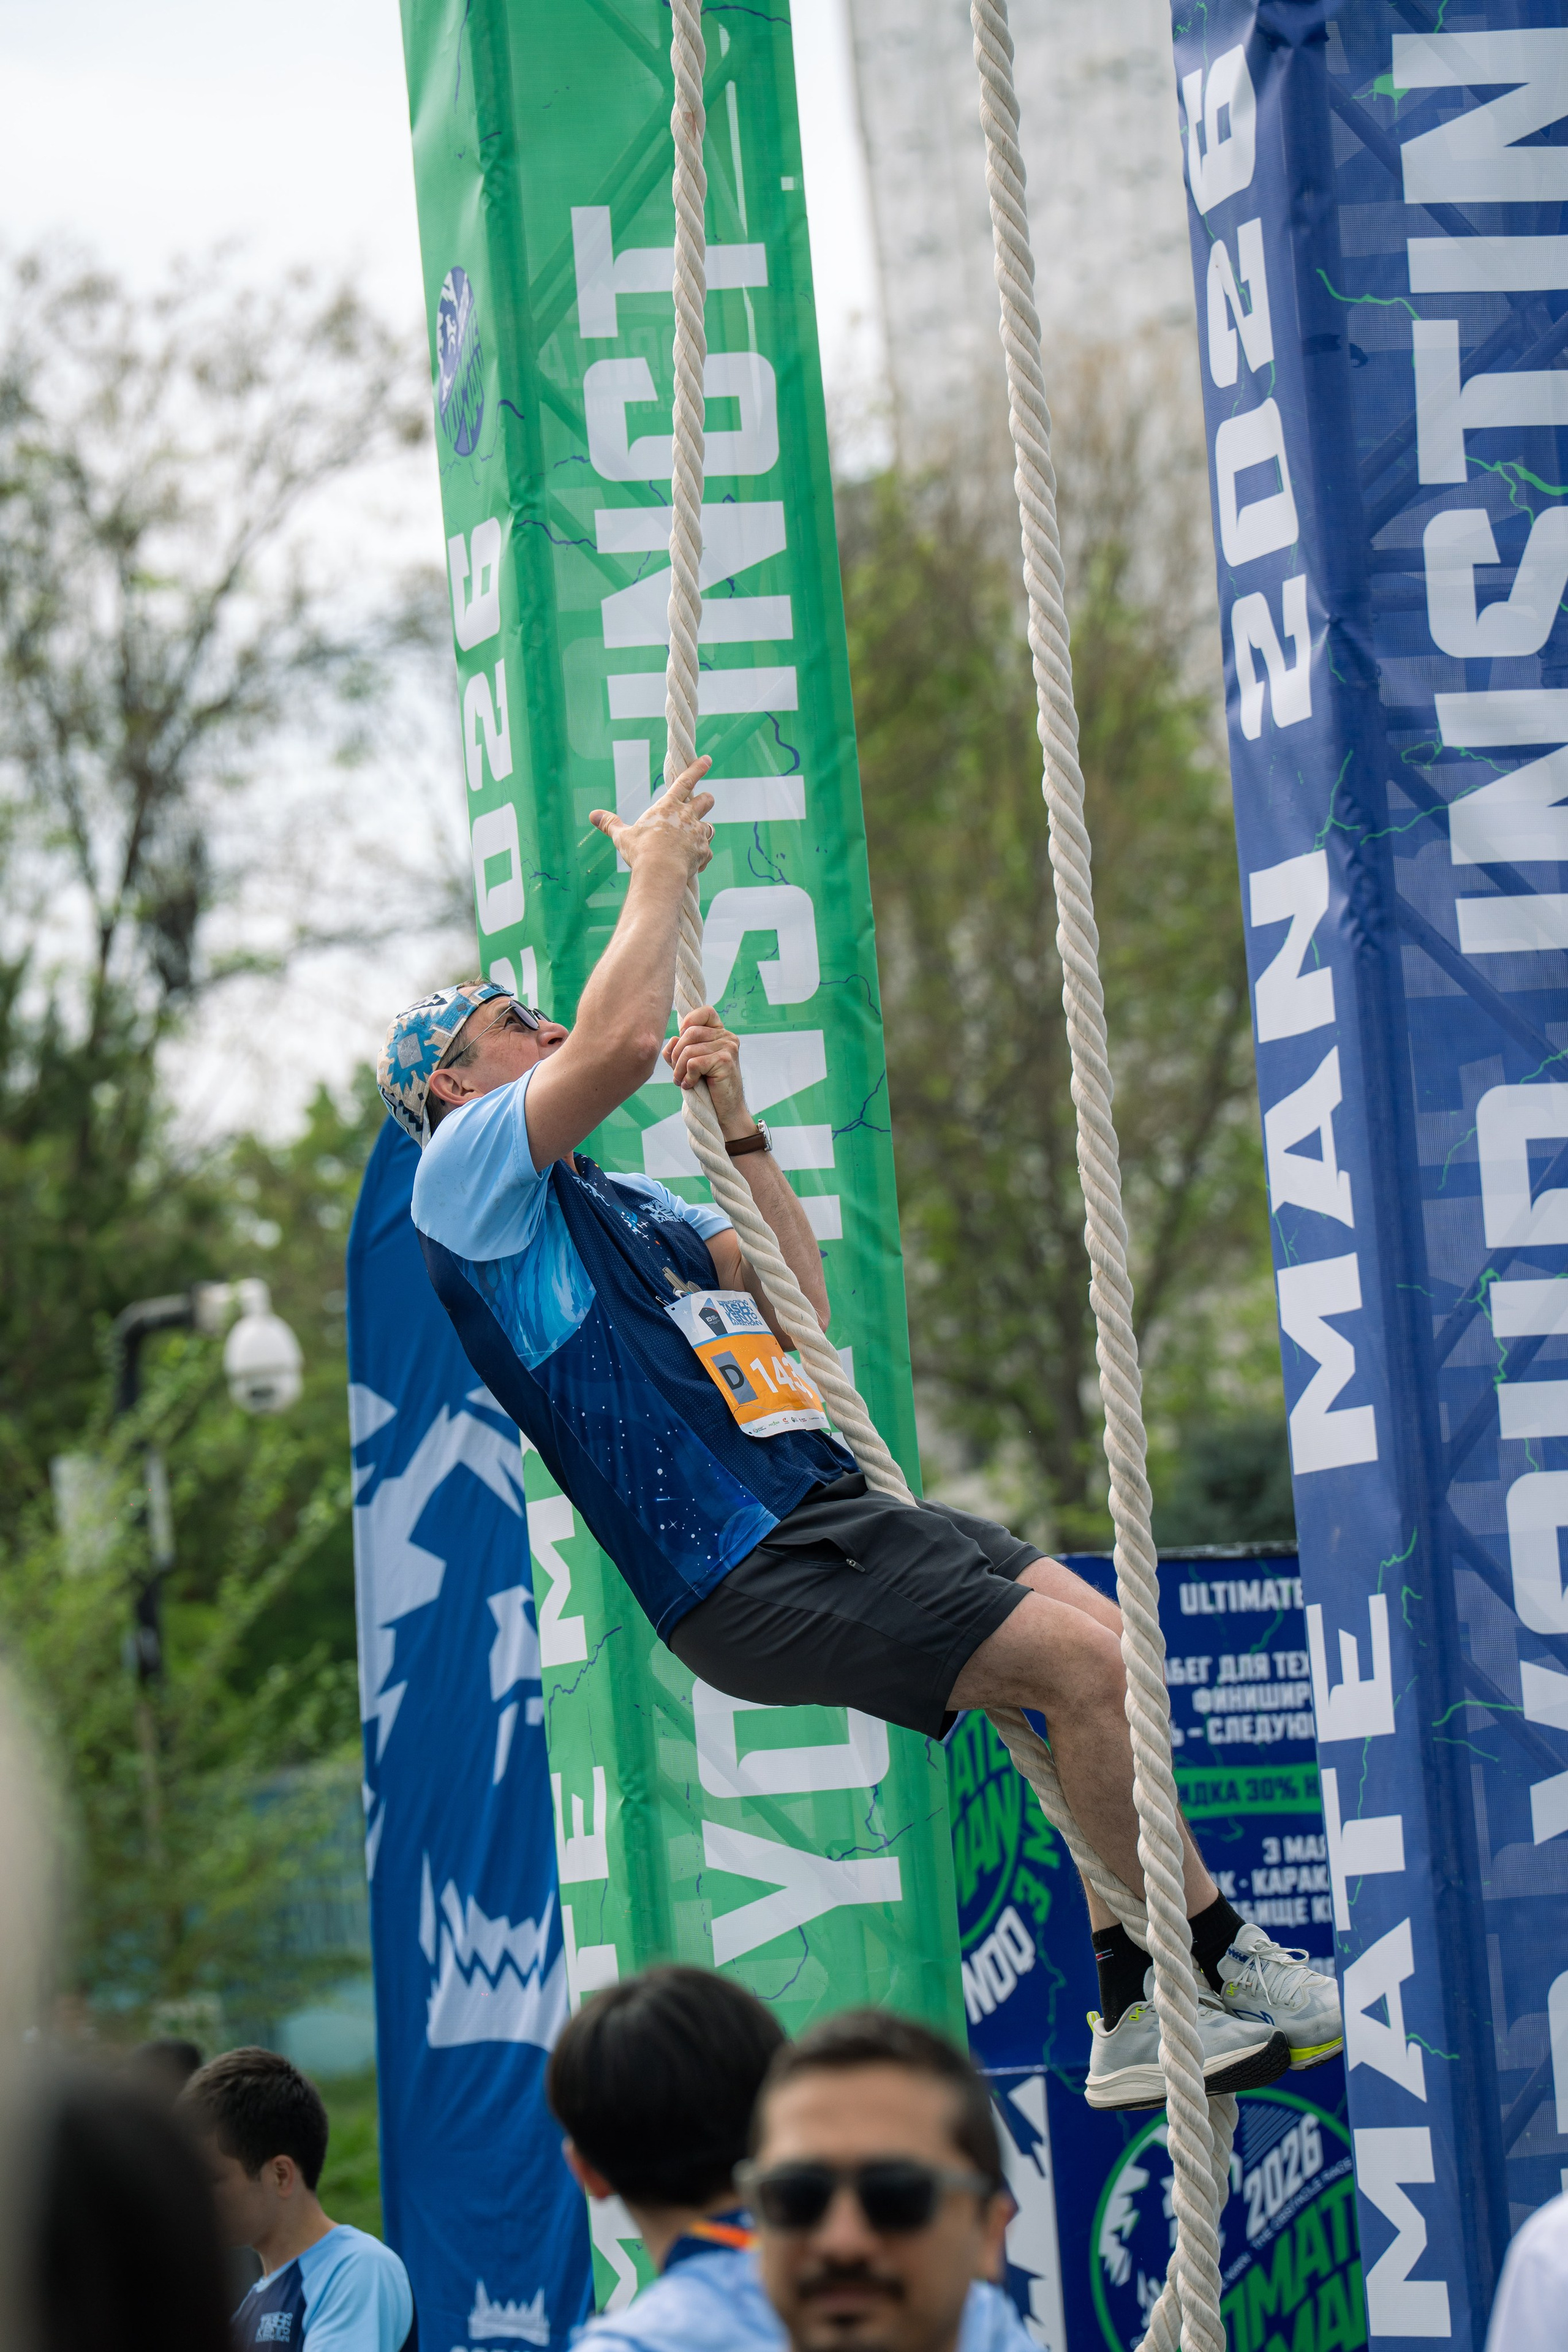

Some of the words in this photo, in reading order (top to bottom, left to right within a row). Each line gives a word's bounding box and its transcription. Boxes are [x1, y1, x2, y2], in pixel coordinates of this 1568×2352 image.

[1183, 44, 1312, 741] 2026
[1249, 849, 1379, 1475] MAN
[718, 1364, 745, 1390] D
[750, 1356, 813, 1399] 143
[1179, 1577, 1304, 1616] ULTIMATE
[1218, 1652, 1272, 1684] ДЛЯ
[1246, 1775, 1300, 1803] 30%
[1262, 1836, 1282, 1866] 3
[1306, 1593, 1451, 2337] MATE
[1243, 2112, 1324, 2242] 2026
